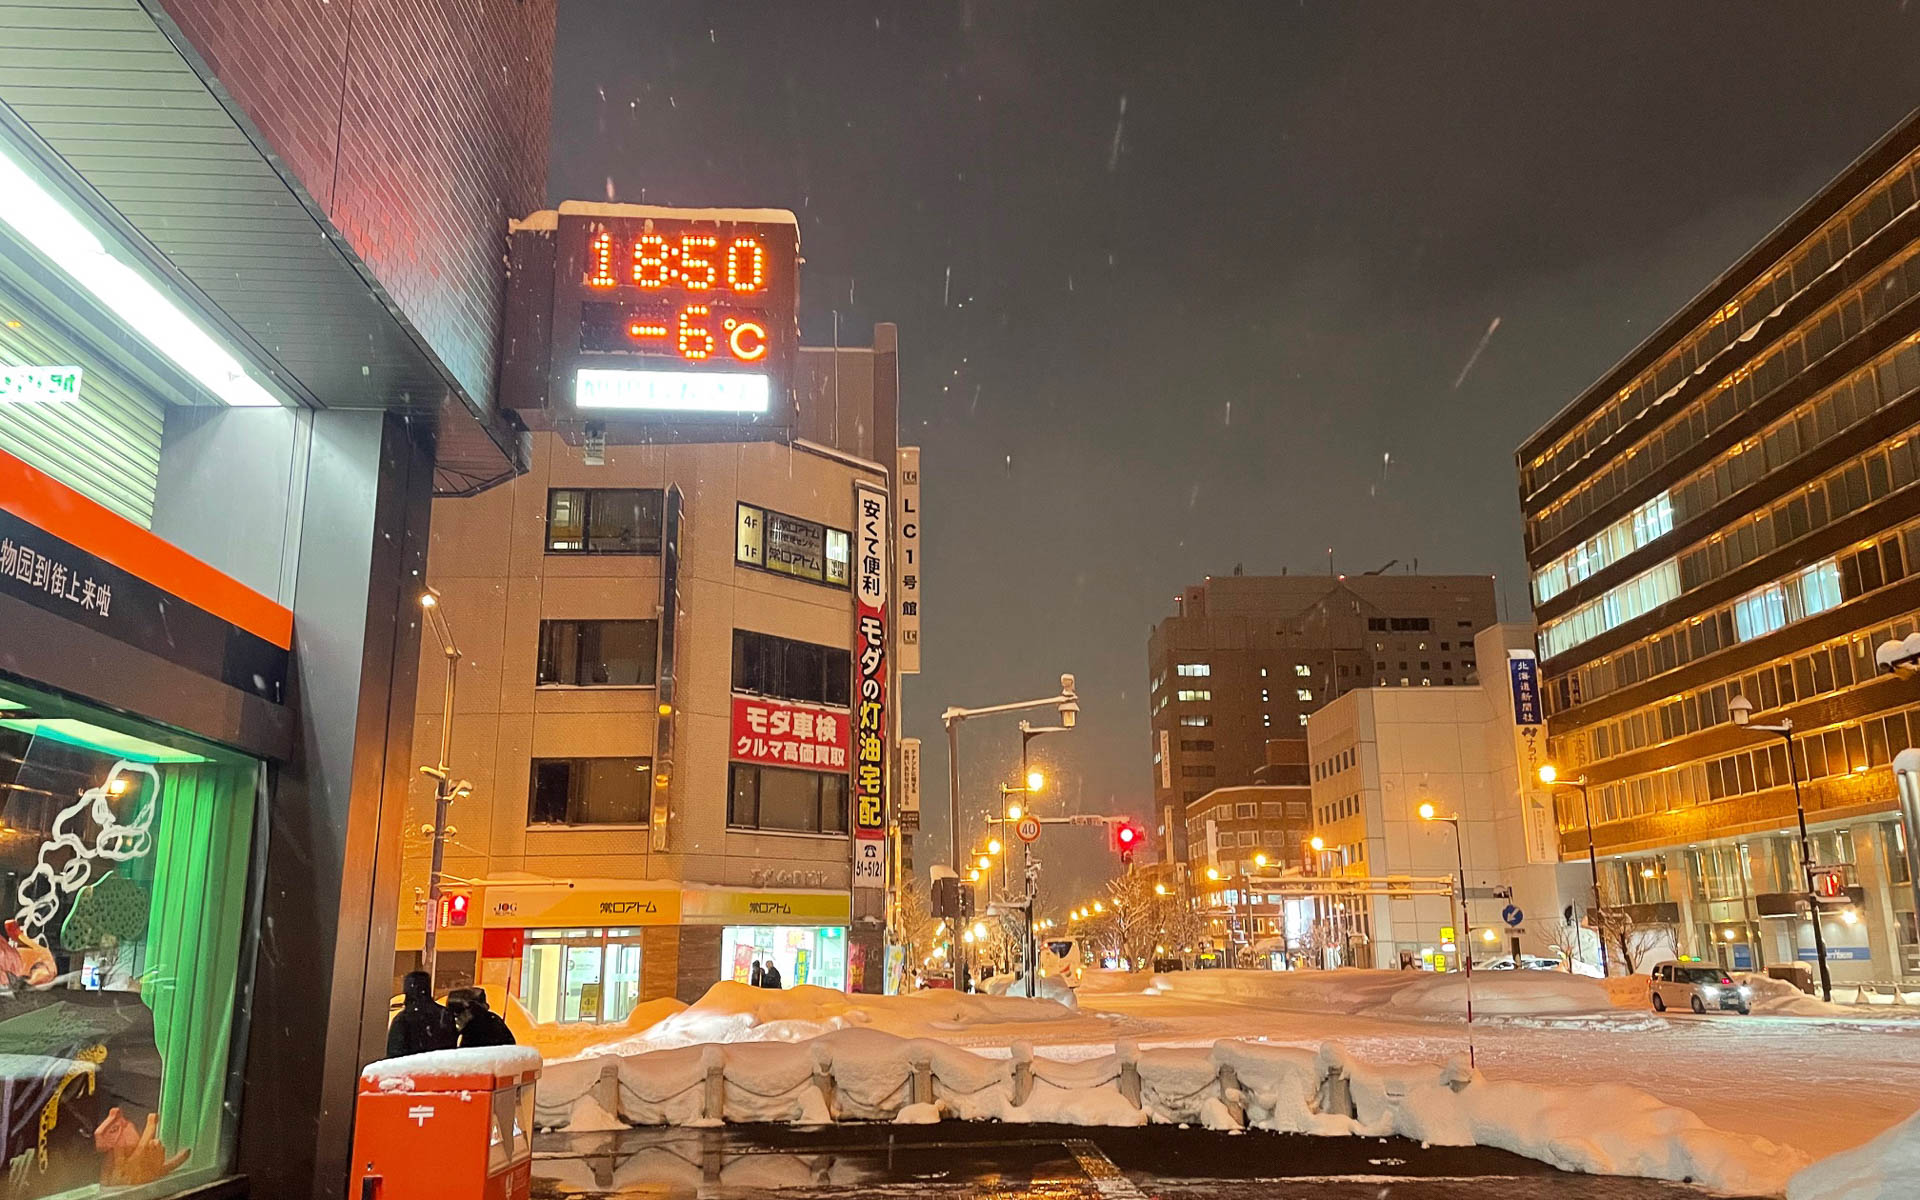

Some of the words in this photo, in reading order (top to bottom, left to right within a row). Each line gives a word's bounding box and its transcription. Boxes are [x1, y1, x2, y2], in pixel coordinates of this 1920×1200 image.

[592, 232, 763, 291] 18:50
[744, 515, 758, 529] 4F
[744, 544, 758, 558] 1F
[862, 499, 881, 597] 安くて便利
[0, 537, 111, 617] 物园到街上来啦
[1517, 660, 1535, 722] 北海道新聞社
[746, 705, 837, 744] モダ車検
[859, 616, 882, 827] モダの灯油宅配
[736, 735, 845, 767] クルマ高価買取
[1022, 823, 1036, 835] 40
[600, 901, 657, 914] 常口アトム
[750, 902, 791, 914] 常口アトム
